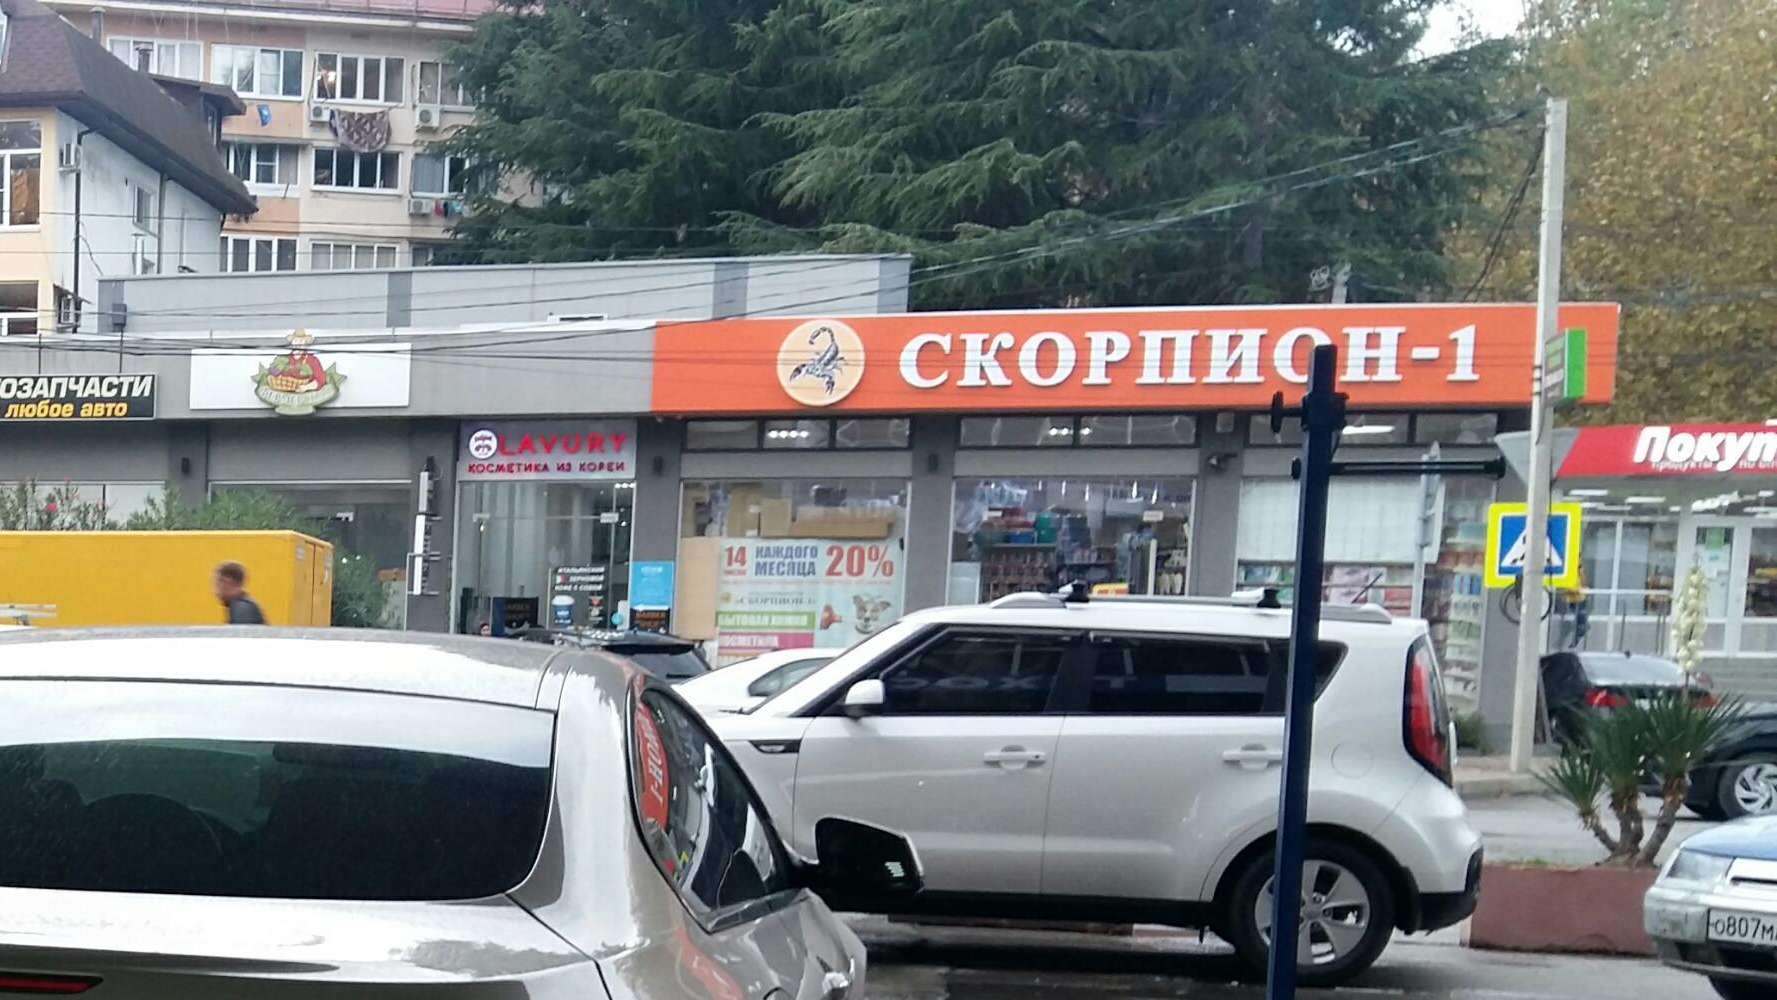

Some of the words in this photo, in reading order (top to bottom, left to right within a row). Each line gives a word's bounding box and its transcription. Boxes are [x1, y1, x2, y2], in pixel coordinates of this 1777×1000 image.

[899, 324, 1480, 387] СКОРПИОН-1
[5, 400, 73, 419] любое
[80, 402, 127, 417] авто
[498, 431, 627, 456] LAVURY
[468, 462, 550, 474] КОСМЕТИКА
[556, 462, 572, 473] ИЗ
[579, 461, 626, 473] КОРЕИ
[724, 546, 747, 567] 14
[755, 545, 819, 560] КАЖДОГО
[824, 544, 895, 577] 20%
[755, 561, 817, 578] МЕСЯЦА
[1714, 915, 1776, 940] О807М
